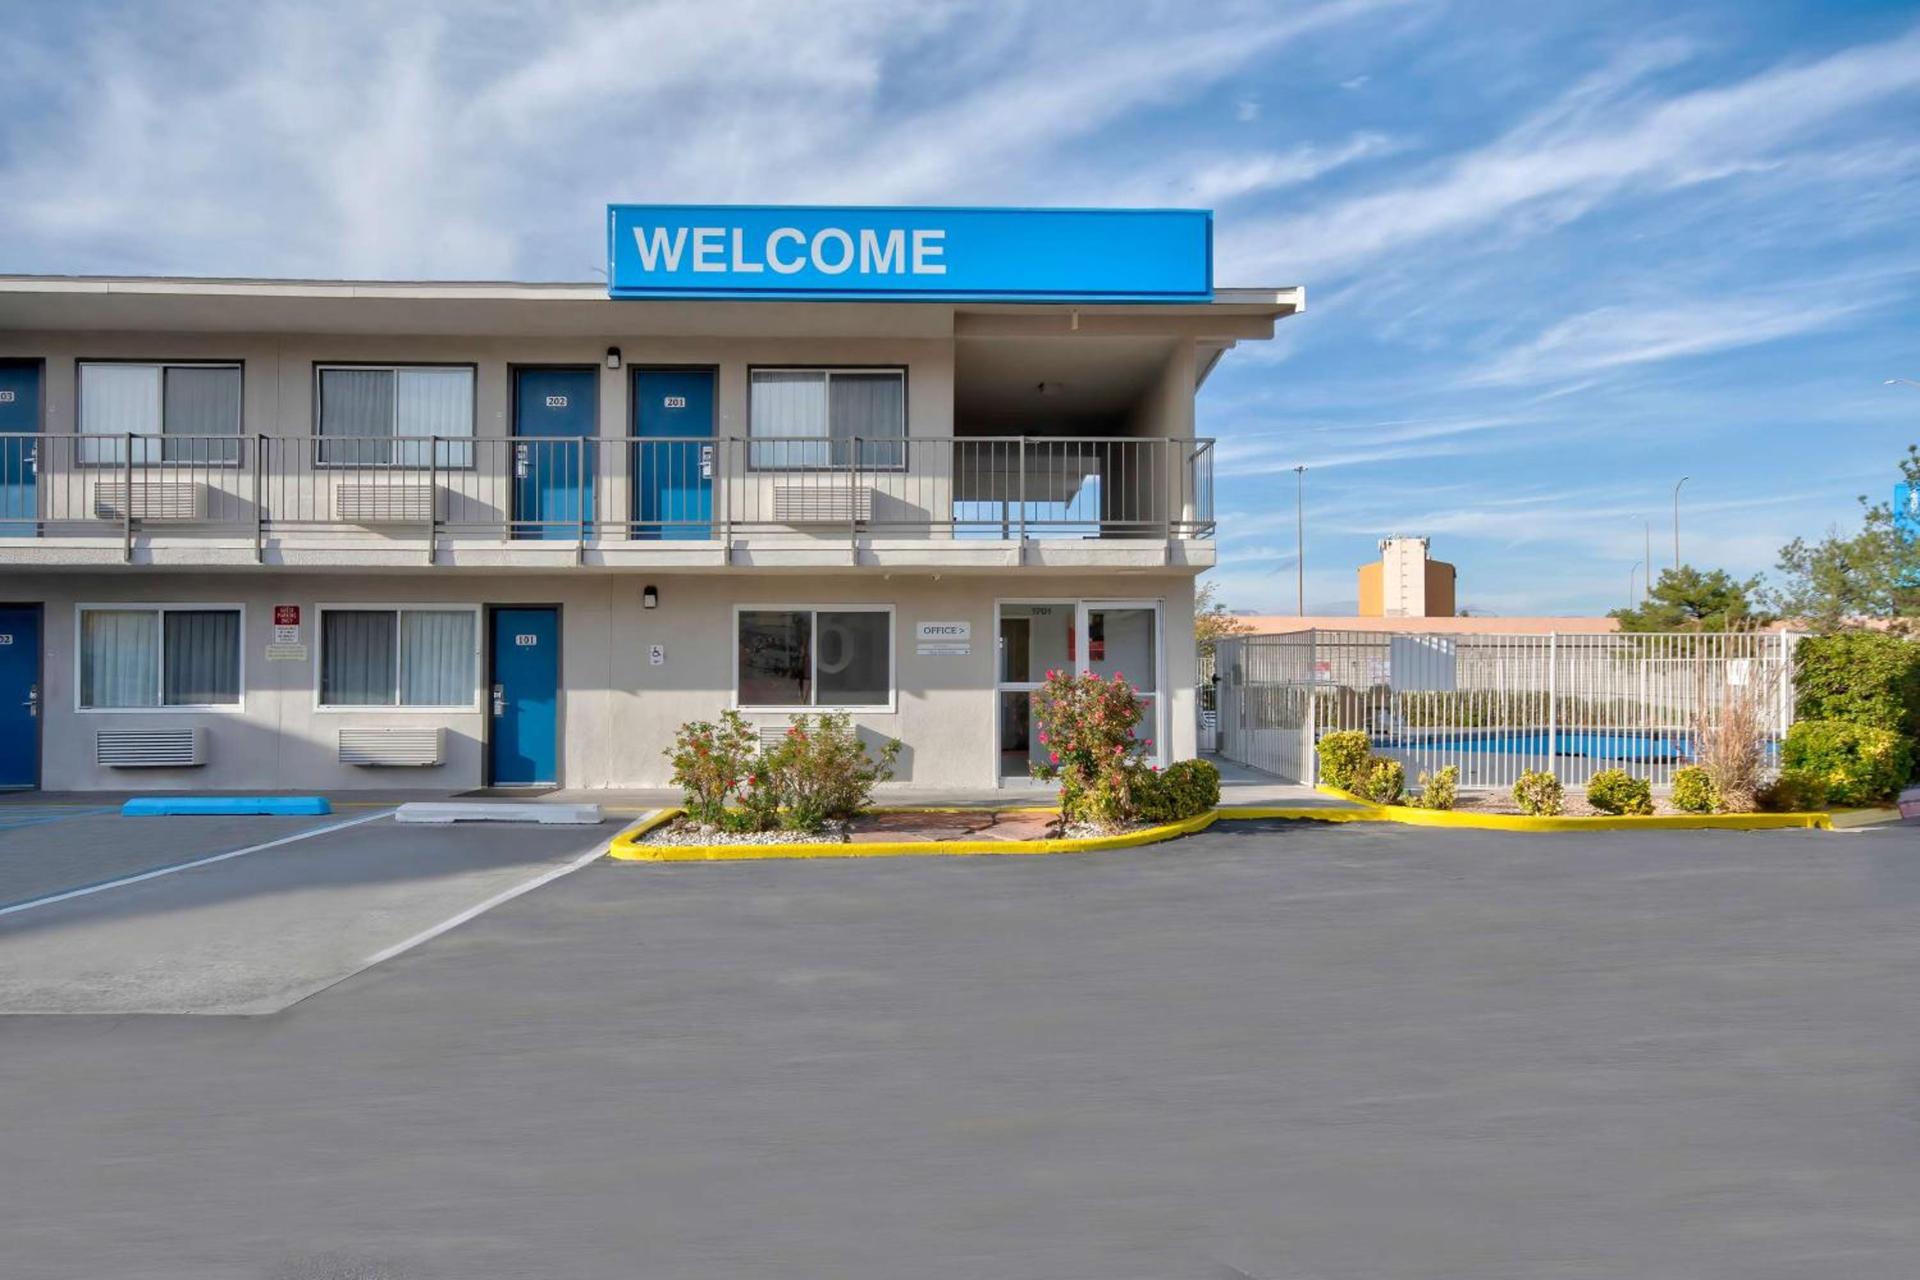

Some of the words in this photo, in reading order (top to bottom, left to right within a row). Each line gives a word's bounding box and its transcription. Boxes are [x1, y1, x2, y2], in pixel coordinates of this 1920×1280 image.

[632, 226, 947, 275] WELCOME
[548, 397, 566, 406] 202
[667, 399, 684, 407] 201
[923, 626, 957, 635] OFFICE
[518, 635, 534, 645] 101
